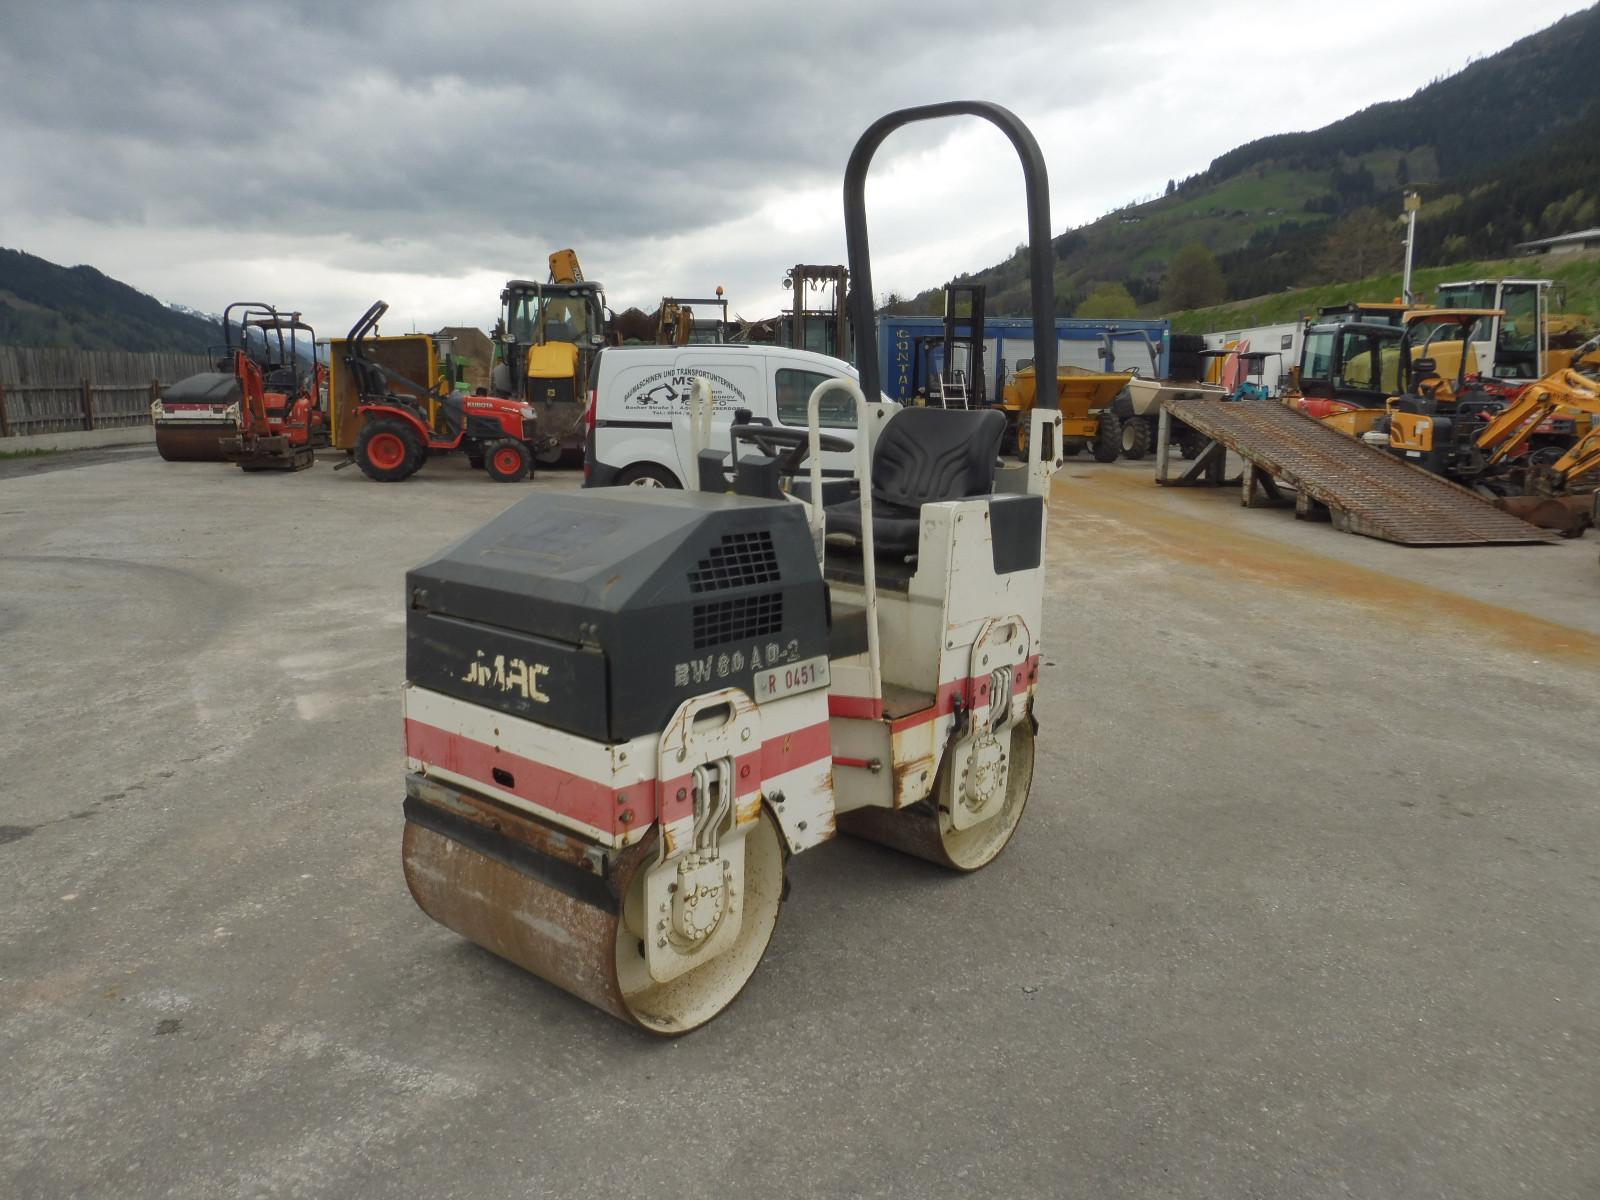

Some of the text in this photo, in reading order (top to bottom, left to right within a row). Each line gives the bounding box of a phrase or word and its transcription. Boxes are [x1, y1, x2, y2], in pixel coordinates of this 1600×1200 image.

[663, 369, 676, 378] UND
[674, 654, 714, 687] BW
[768, 663, 816, 694] R 0451
